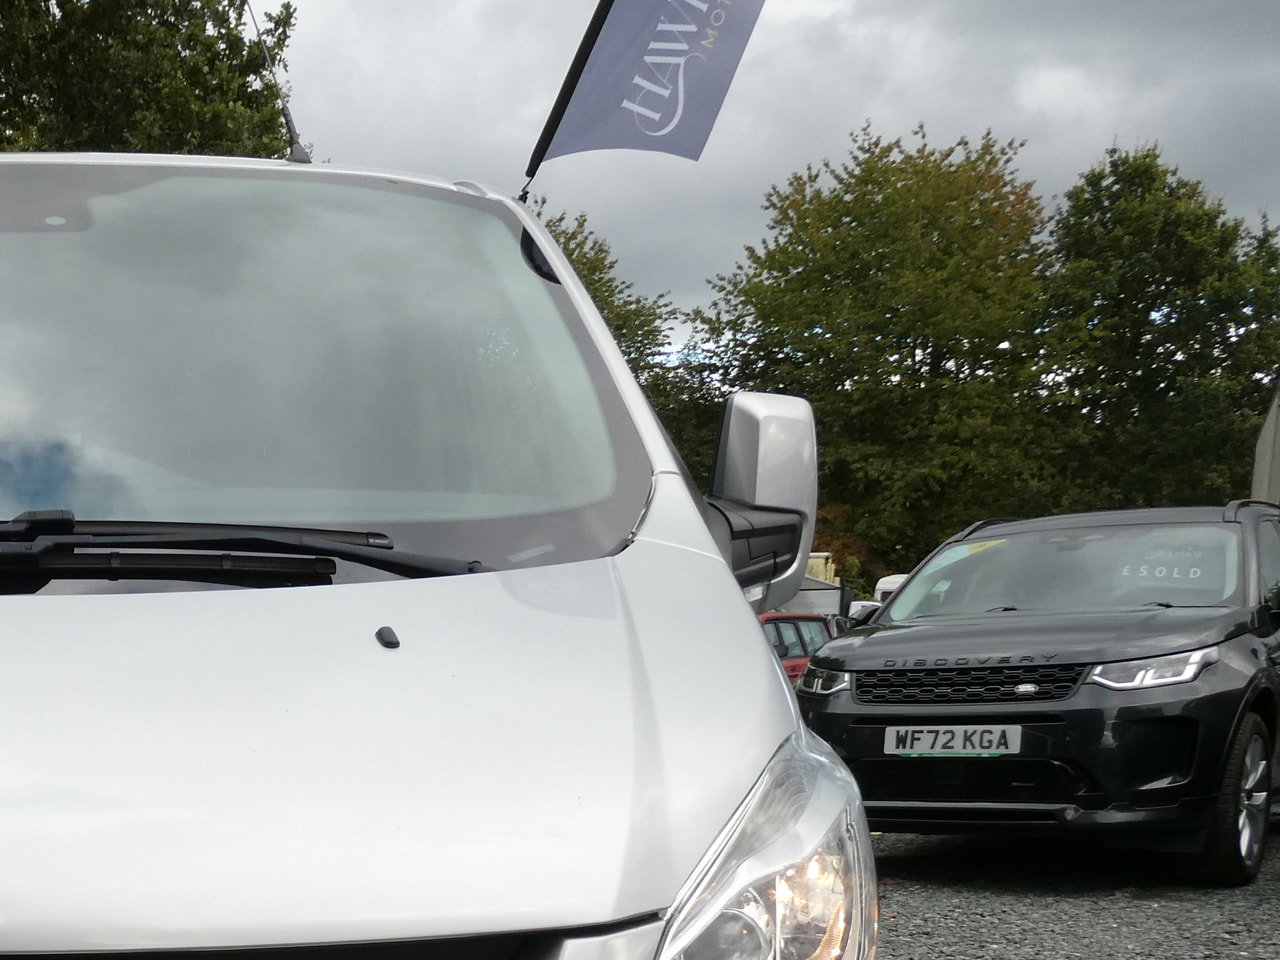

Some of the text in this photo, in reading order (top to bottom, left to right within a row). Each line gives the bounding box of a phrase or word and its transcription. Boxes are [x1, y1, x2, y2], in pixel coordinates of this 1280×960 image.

[883, 653, 1058, 668] DISCOVERY
[895, 729, 1009, 750] WF72 KGA
